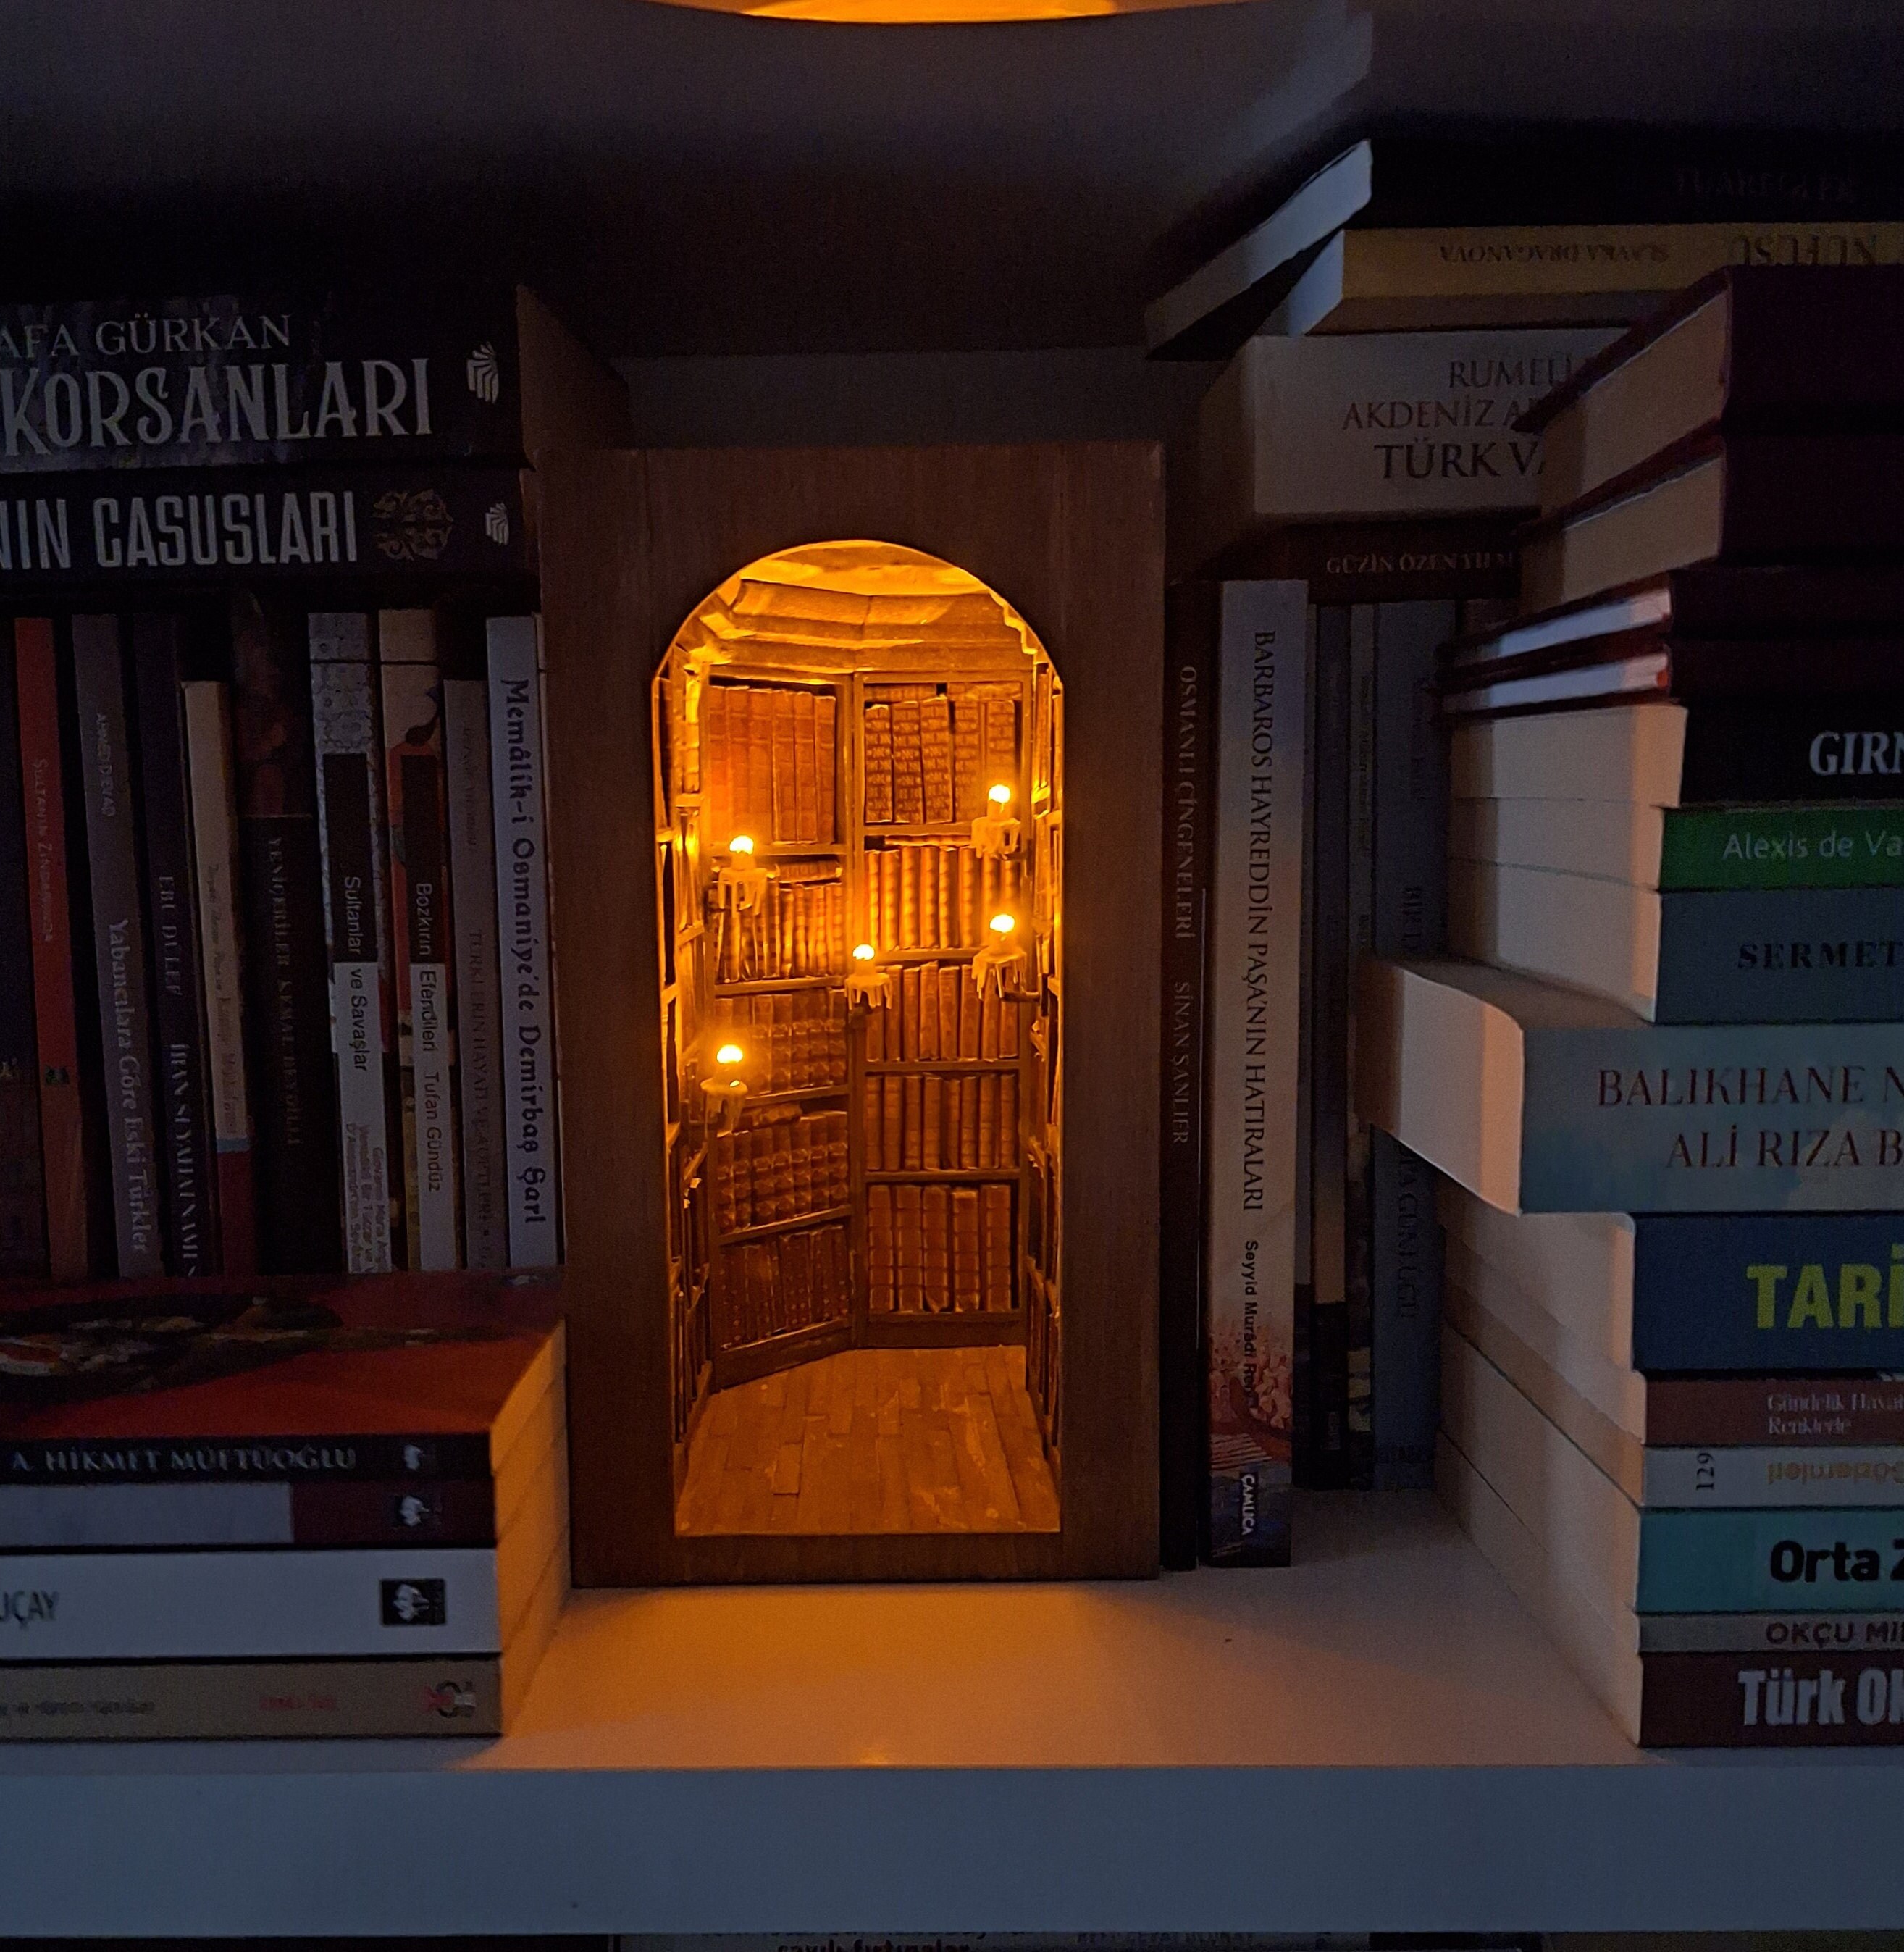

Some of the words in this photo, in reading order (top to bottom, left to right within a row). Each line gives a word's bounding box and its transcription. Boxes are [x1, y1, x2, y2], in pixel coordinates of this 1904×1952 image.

[96, 311, 291, 356] GÜRKAN
[0, 358, 435, 456] KORSANLARI
[1341, 395, 1495, 430] AKDENİZ
[1374, 437, 1501, 479] TÜRK
[1508, 440, 1547, 477] V
[93, 490, 358, 568] CASUSLARI
[1251, 630, 1276, 768] BARBAROS
[501, 679, 533, 824] Memâlik-i
[1247, 774, 1273, 934] HAYREDDİN
[1721, 832, 1809, 860] Alexis
[1818, 830, 1854, 858] de
[340, 875, 366, 956] Sultanlar
[414, 881, 437, 958] Bozkırın
[109, 917, 136, 1052] Yabancılara
[349, 968, 362, 991] ve
[1737, 940, 1903, 971] SERMET
[417, 969, 442, 1055] Efendileri
[1170, 981, 1192, 1047] SİNAN
[1241, 942, 1269, 1056] PAŞA'NIN
[349, 995, 372, 1073] Savaşlar
[116, 1054, 143, 1111] Göre
[423, 1072, 443, 1123] Tufan
[517, 1024, 543, 1153] Demirbaş
[1598, 1065, 1867, 1107] BALIKHANE
[122, 1115, 146, 1166] Eski
[424, 1126, 448, 1194] Gündüz
[1243, 1065, 1266, 1211] HATIRALARI
[1666, 1124, 1738, 1169] ALİ
[1757, 1128, 1860, 1169] RIZA
[125, 1168, 154, 1256] Türkler
[517, 1166, 546, 1226] Şarl
[1243, 1240, 1259, 1297] Seyyid
[1696, 1451, 1715, 1492] 129
[1240, 1473, 1260, 1536] ÇAMLICA
[1770, 1538, 1880, 1583] Orta
[1765, 1620, 1854, 1649] OKÇU
[1737, 1666, 1845, 1727] Türk
